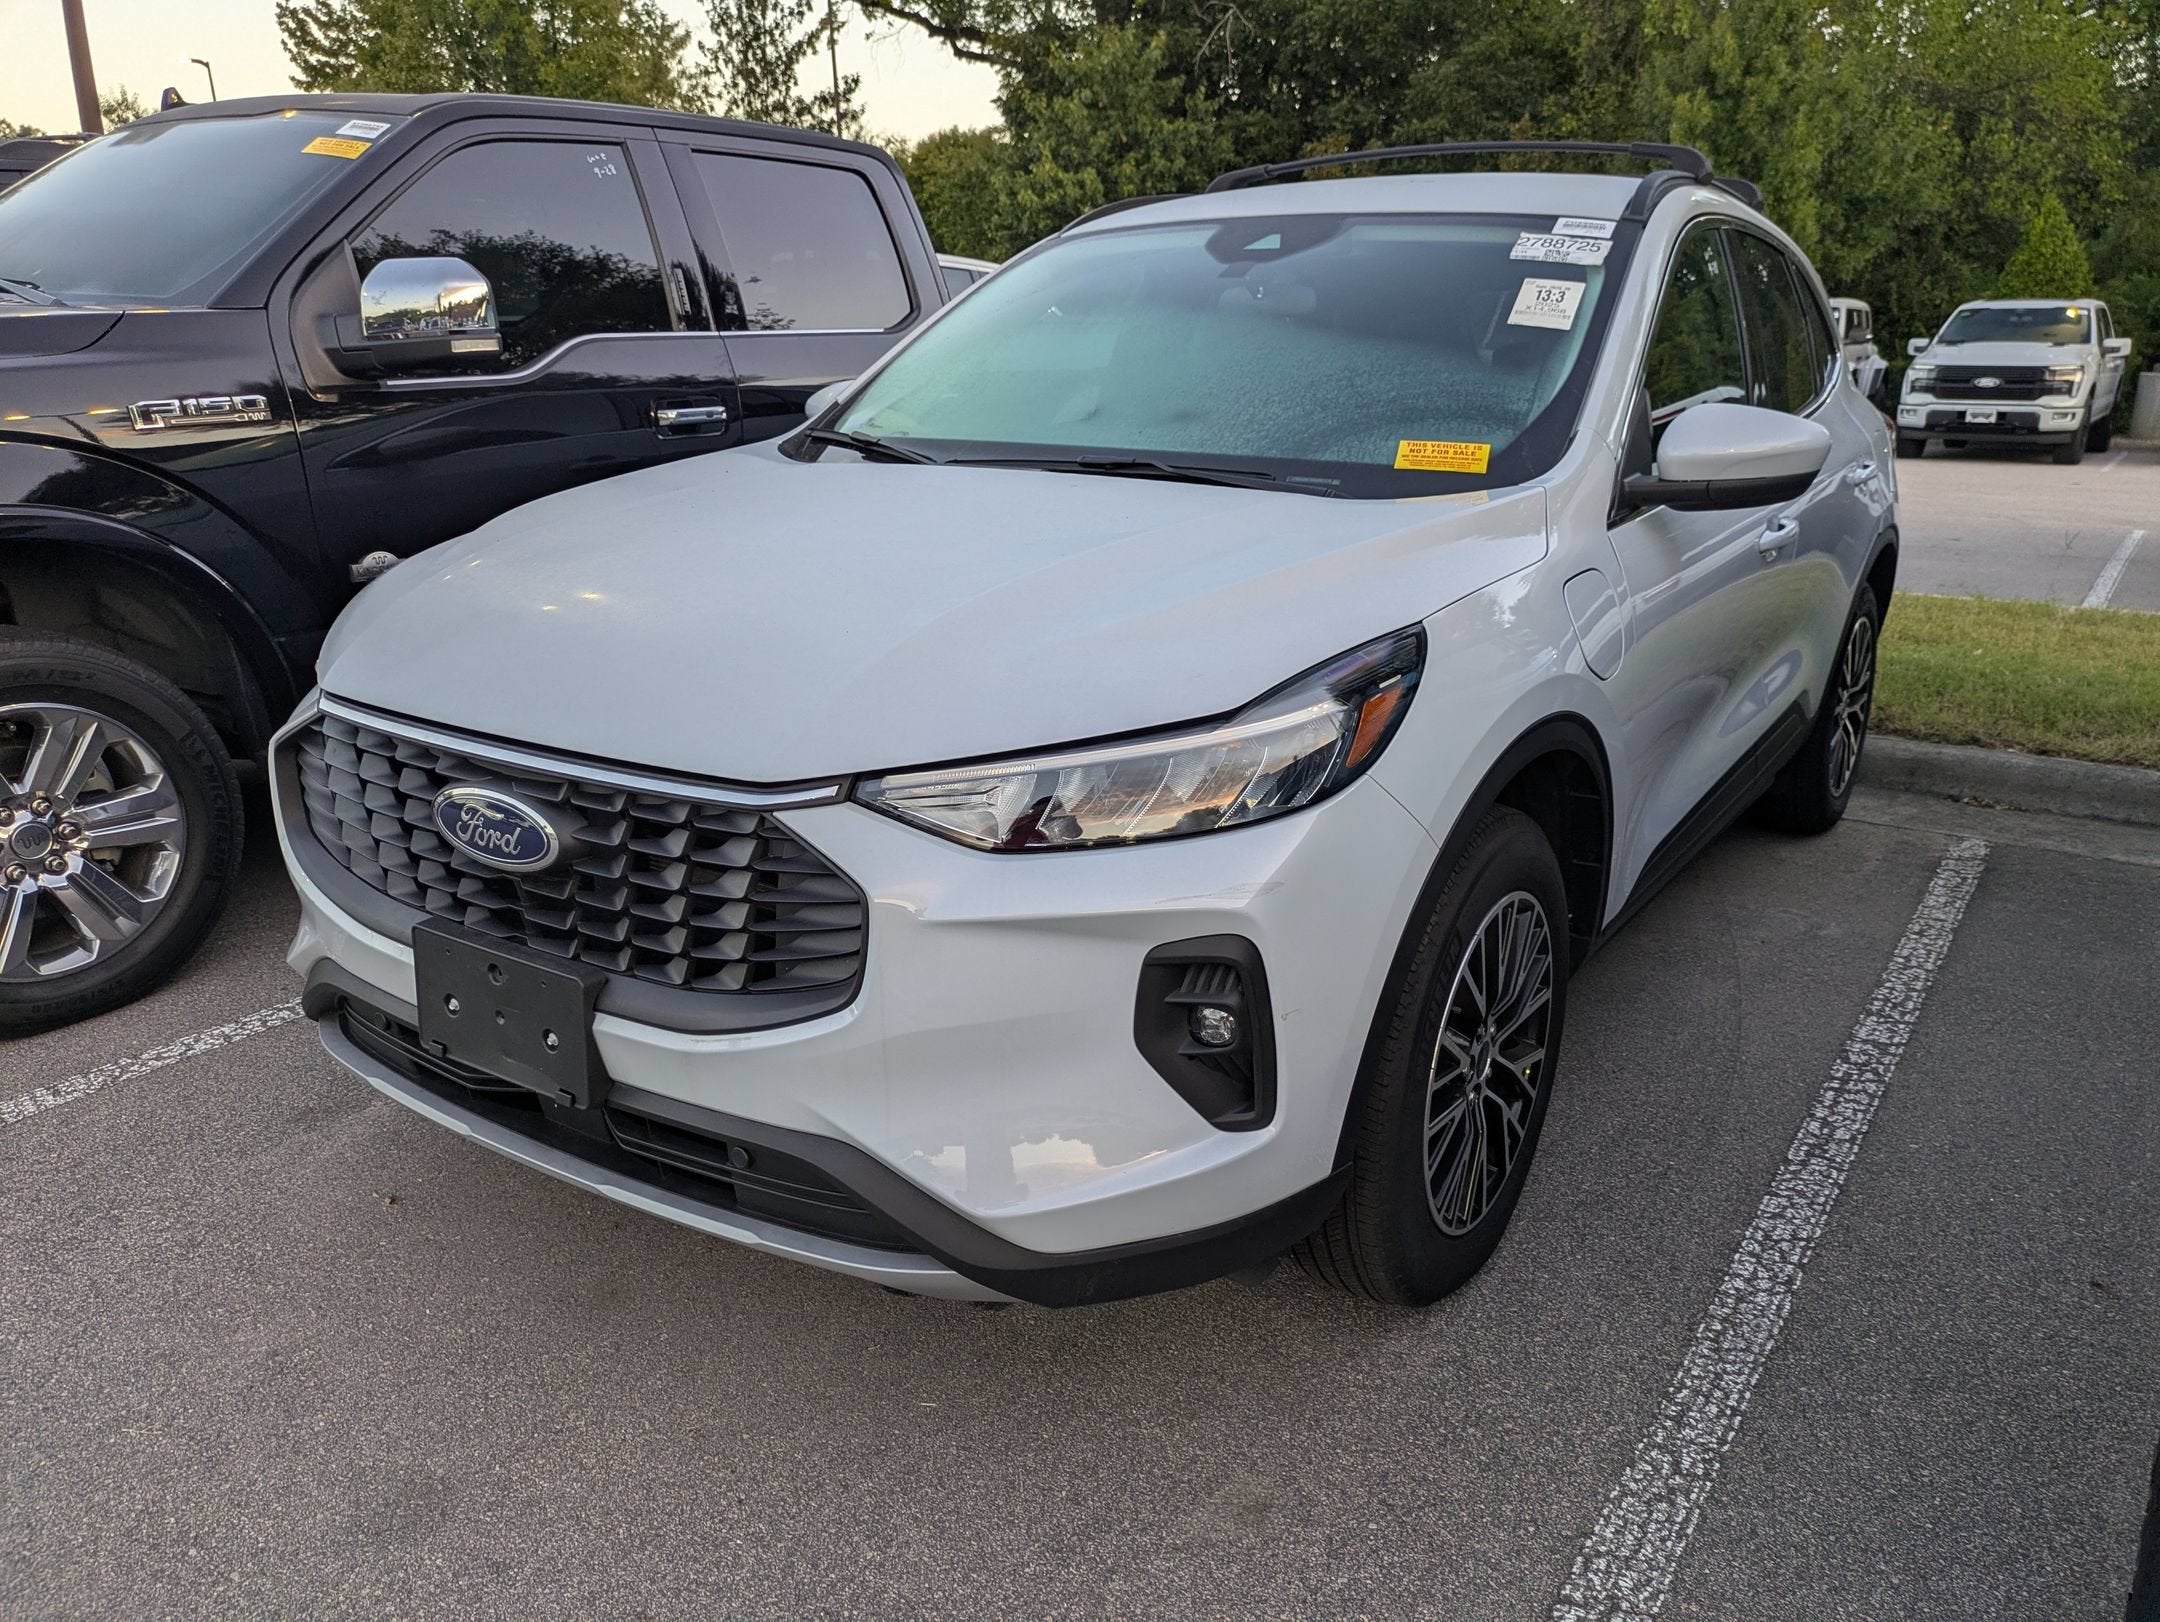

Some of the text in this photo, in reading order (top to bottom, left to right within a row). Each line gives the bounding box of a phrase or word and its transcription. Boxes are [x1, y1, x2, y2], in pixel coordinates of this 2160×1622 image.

[1517, 236, 1602, 253] 2788725
[1431, 443, 1471, 451] VEHICLE
[455, 803, 521, 856] Ford
